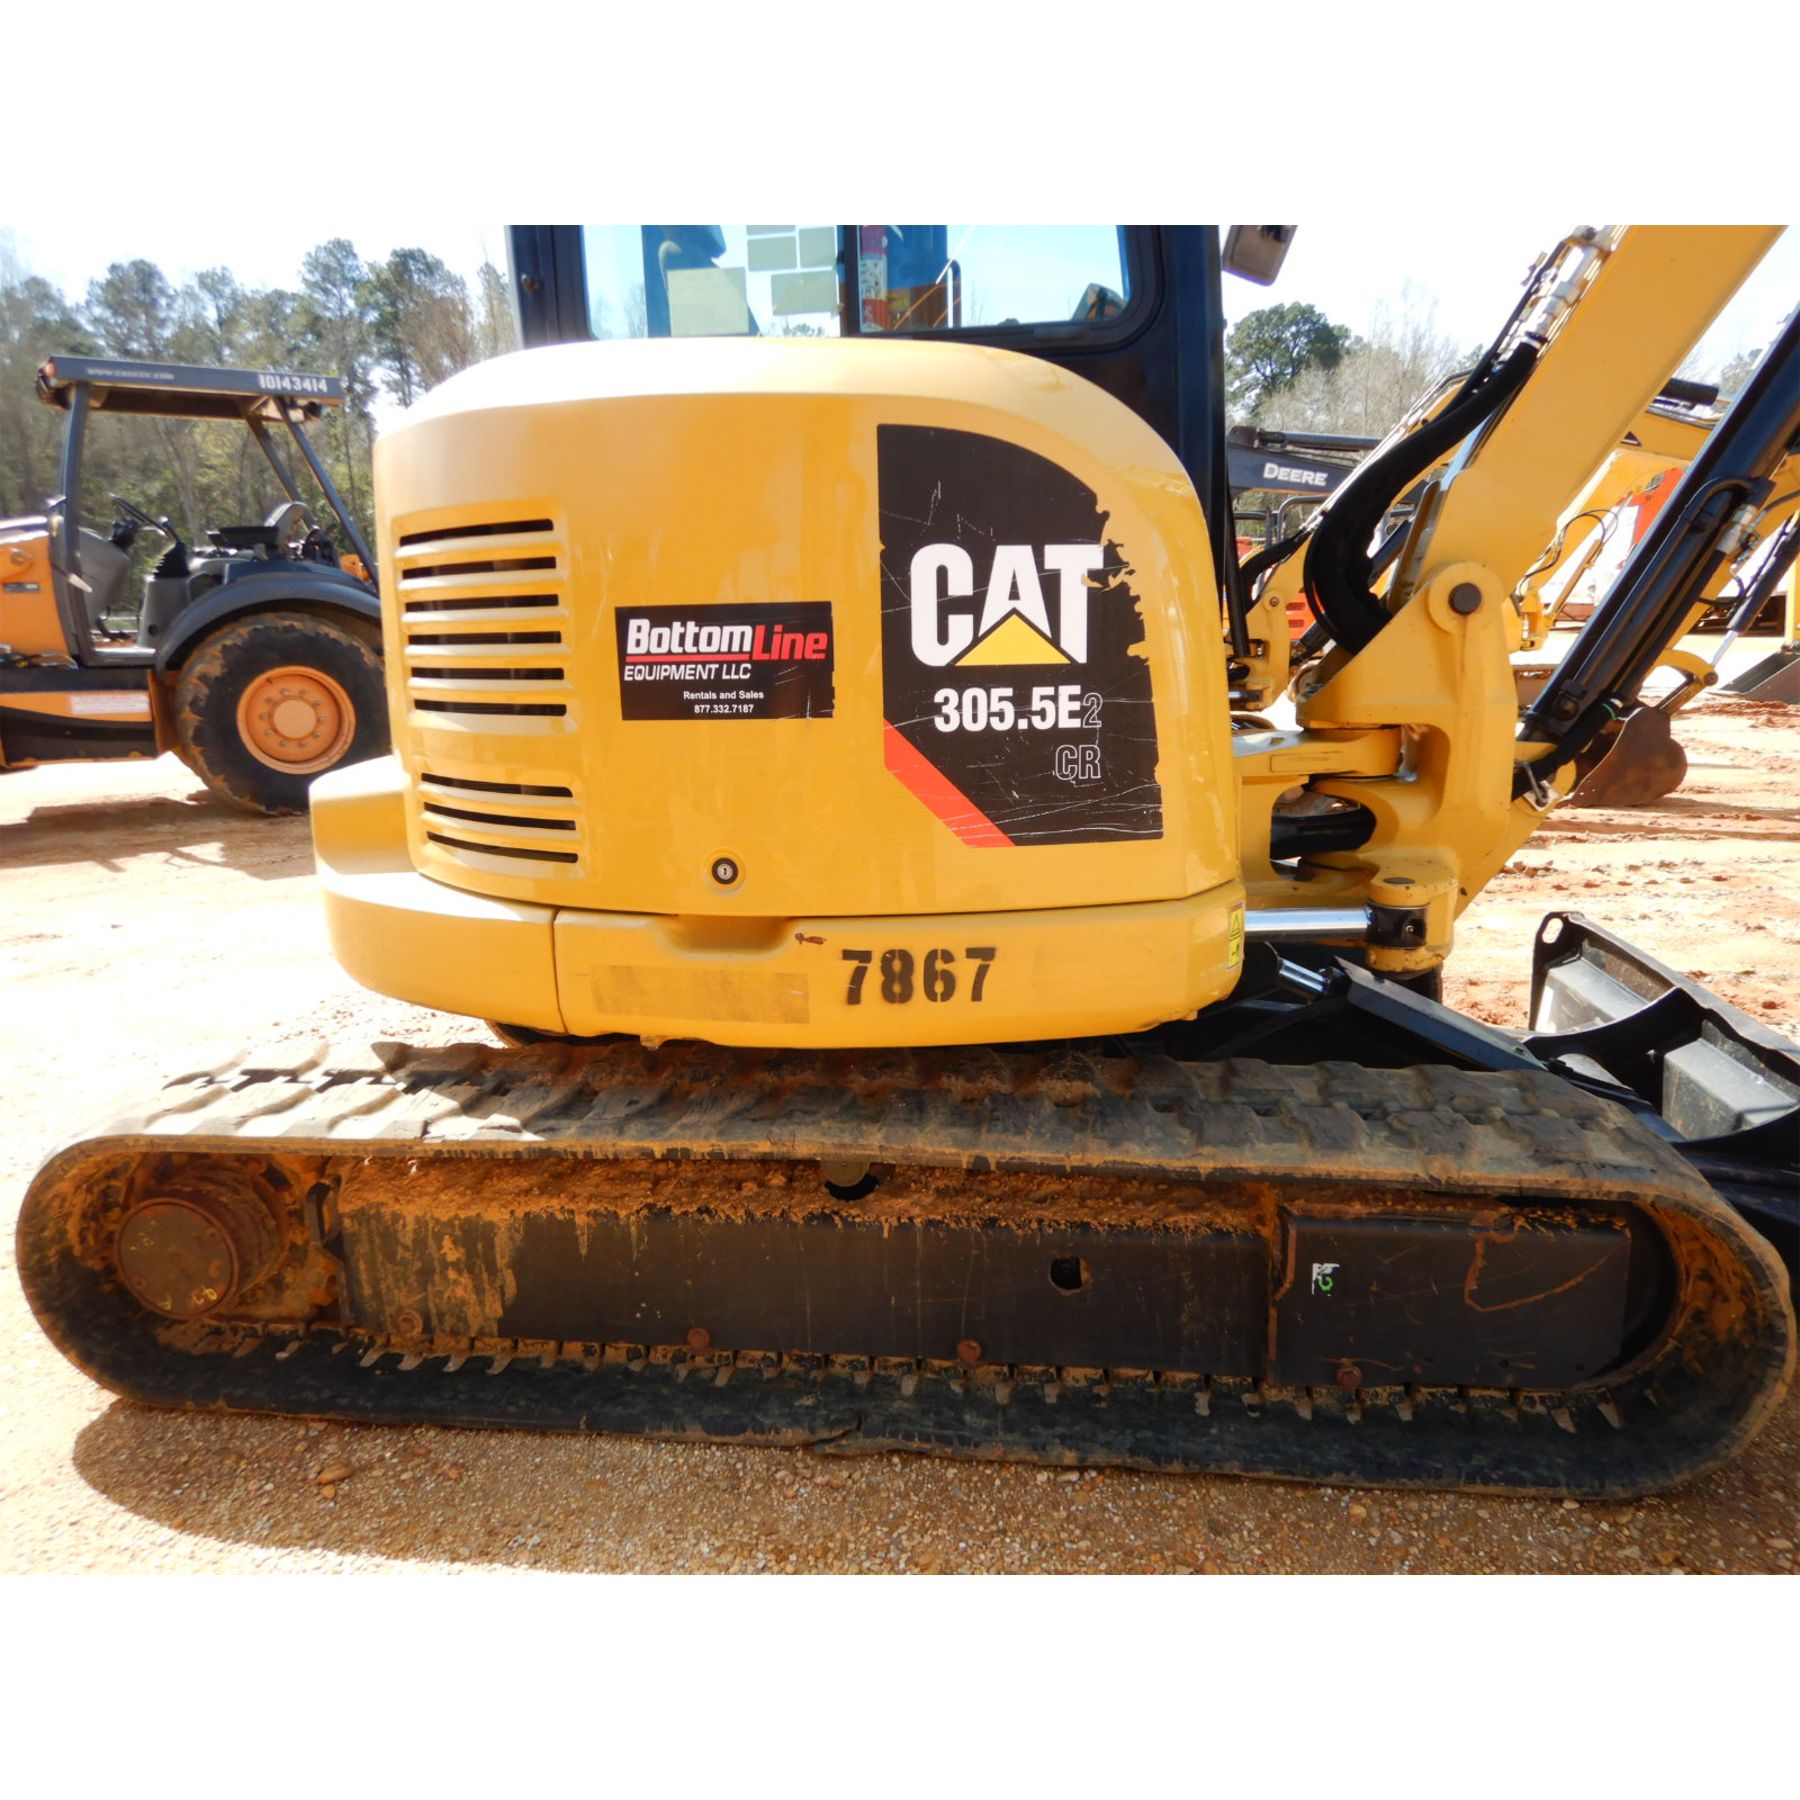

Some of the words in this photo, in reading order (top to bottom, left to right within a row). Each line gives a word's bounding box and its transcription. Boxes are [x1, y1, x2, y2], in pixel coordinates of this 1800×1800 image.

[259, 374, 328, 393] 10143414
[1263, 462, 1328, 486] DEERE
[910, 543, 1104, 667] CAT
[623, 663, 719, 681] EQUIPMENT
[721, 663, 752, 680] LLC
[683, 691, 717, 700] Rentals
[719, 691, 737, 700] and
[739, 690, 765, 700] Sales
[694, 704, 755, 714] 877.332.7187
[1055, 744, 1102, 781] CR
[841, 947, 997, 1006] 7867
